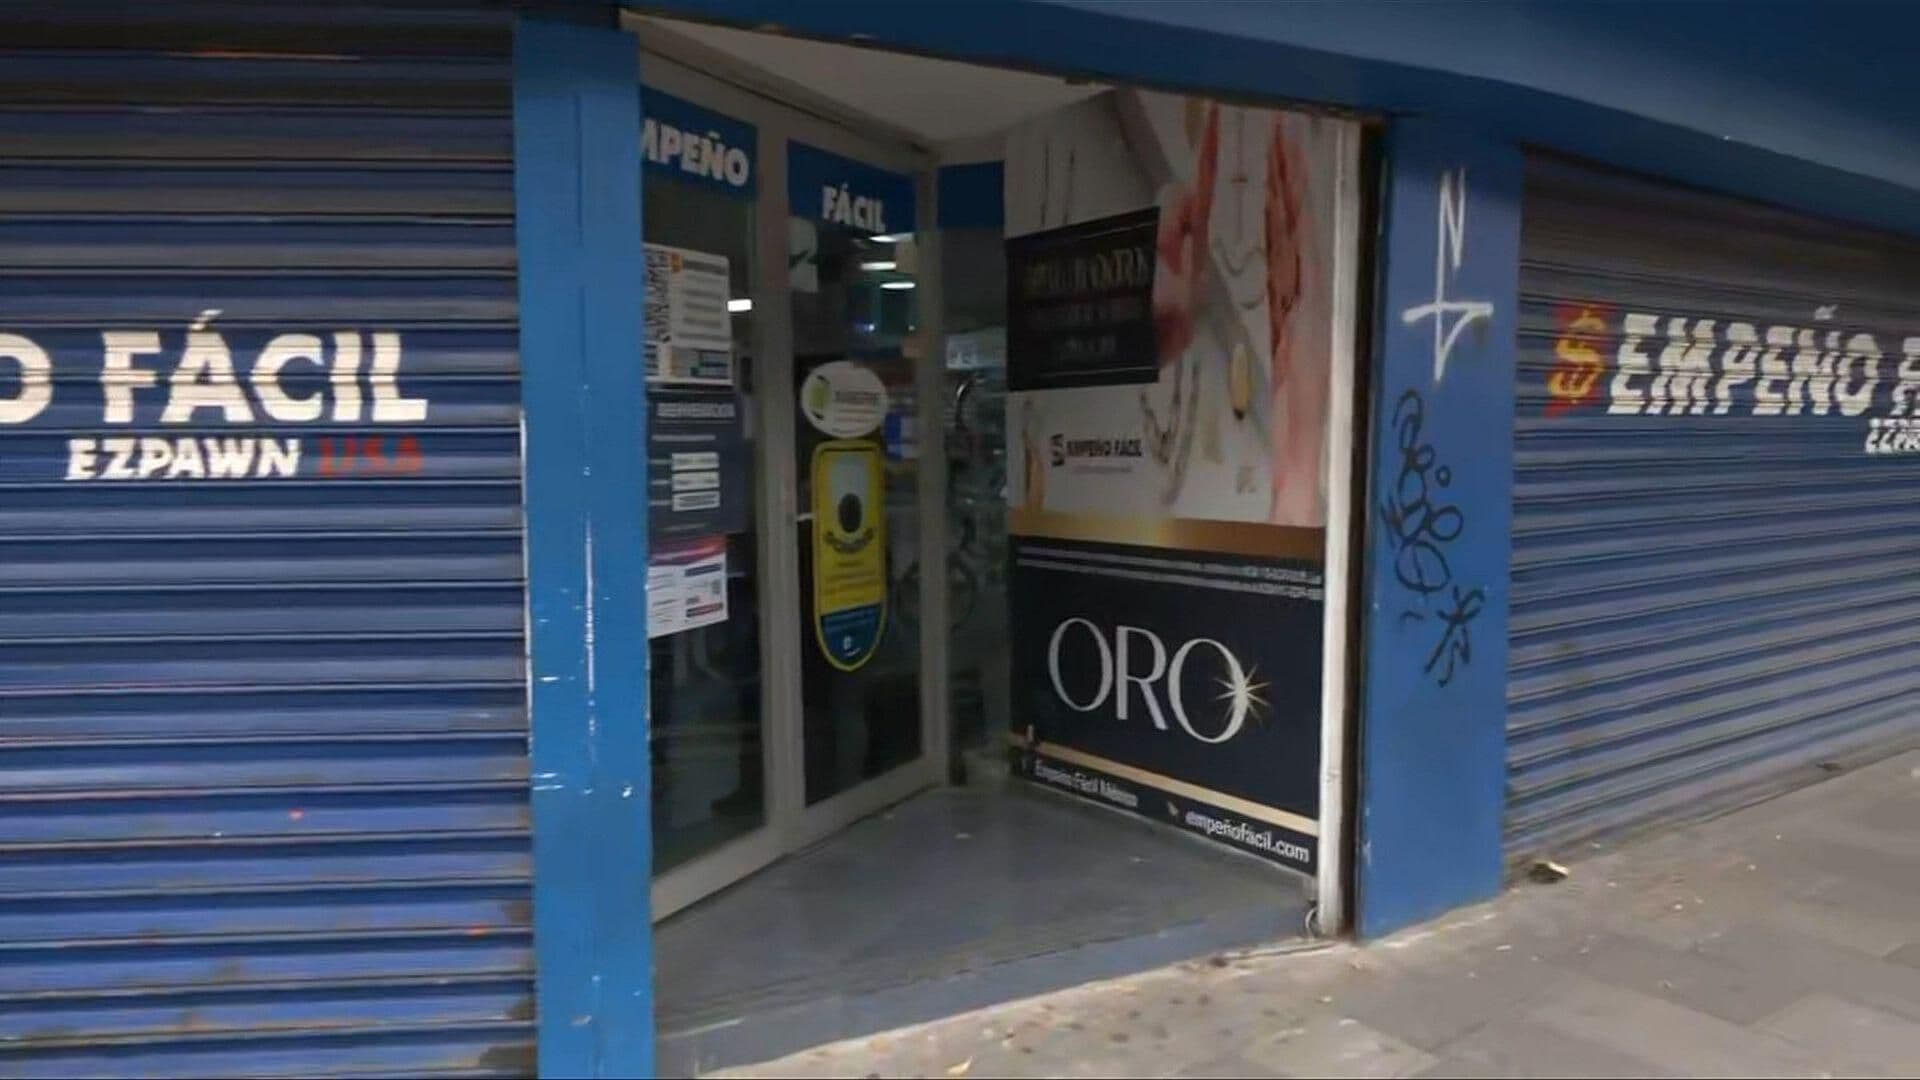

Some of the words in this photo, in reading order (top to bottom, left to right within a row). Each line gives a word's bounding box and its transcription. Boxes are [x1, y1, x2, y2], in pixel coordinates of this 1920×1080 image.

[101, 309, 428, 423] FÁCIL
[1606, 304, 1882, 416] EMPEÑO
[65, 438, 302, 481] EZPAWN
[1048, 617, 1250, 743] ORO
